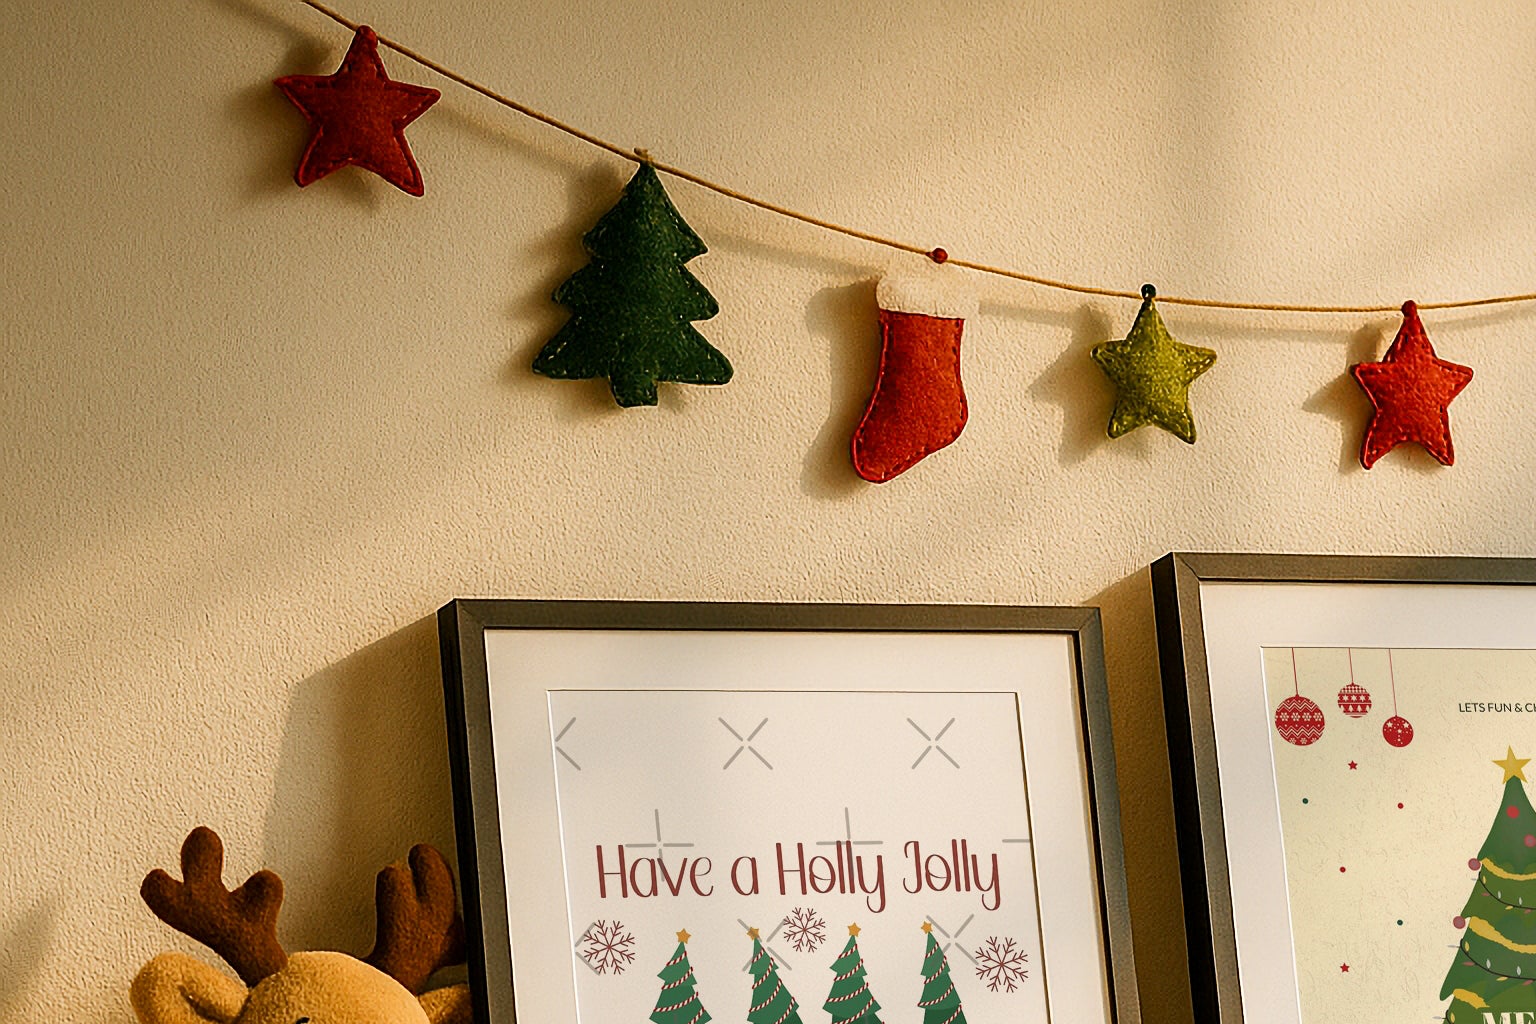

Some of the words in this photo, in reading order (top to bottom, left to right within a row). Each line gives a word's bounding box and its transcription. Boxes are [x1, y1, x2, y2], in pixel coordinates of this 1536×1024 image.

[1458, 702, 1486, 713] LETS
[1487, 702, 1512, 713] FUN
[1514, 702, 1523, 713] &
[596, 844, 714, 899] Have
[730, 855, 760, 896] a
[776, 839, 886, 914] Holly
[902, 838, 1001, 912] Jolly
